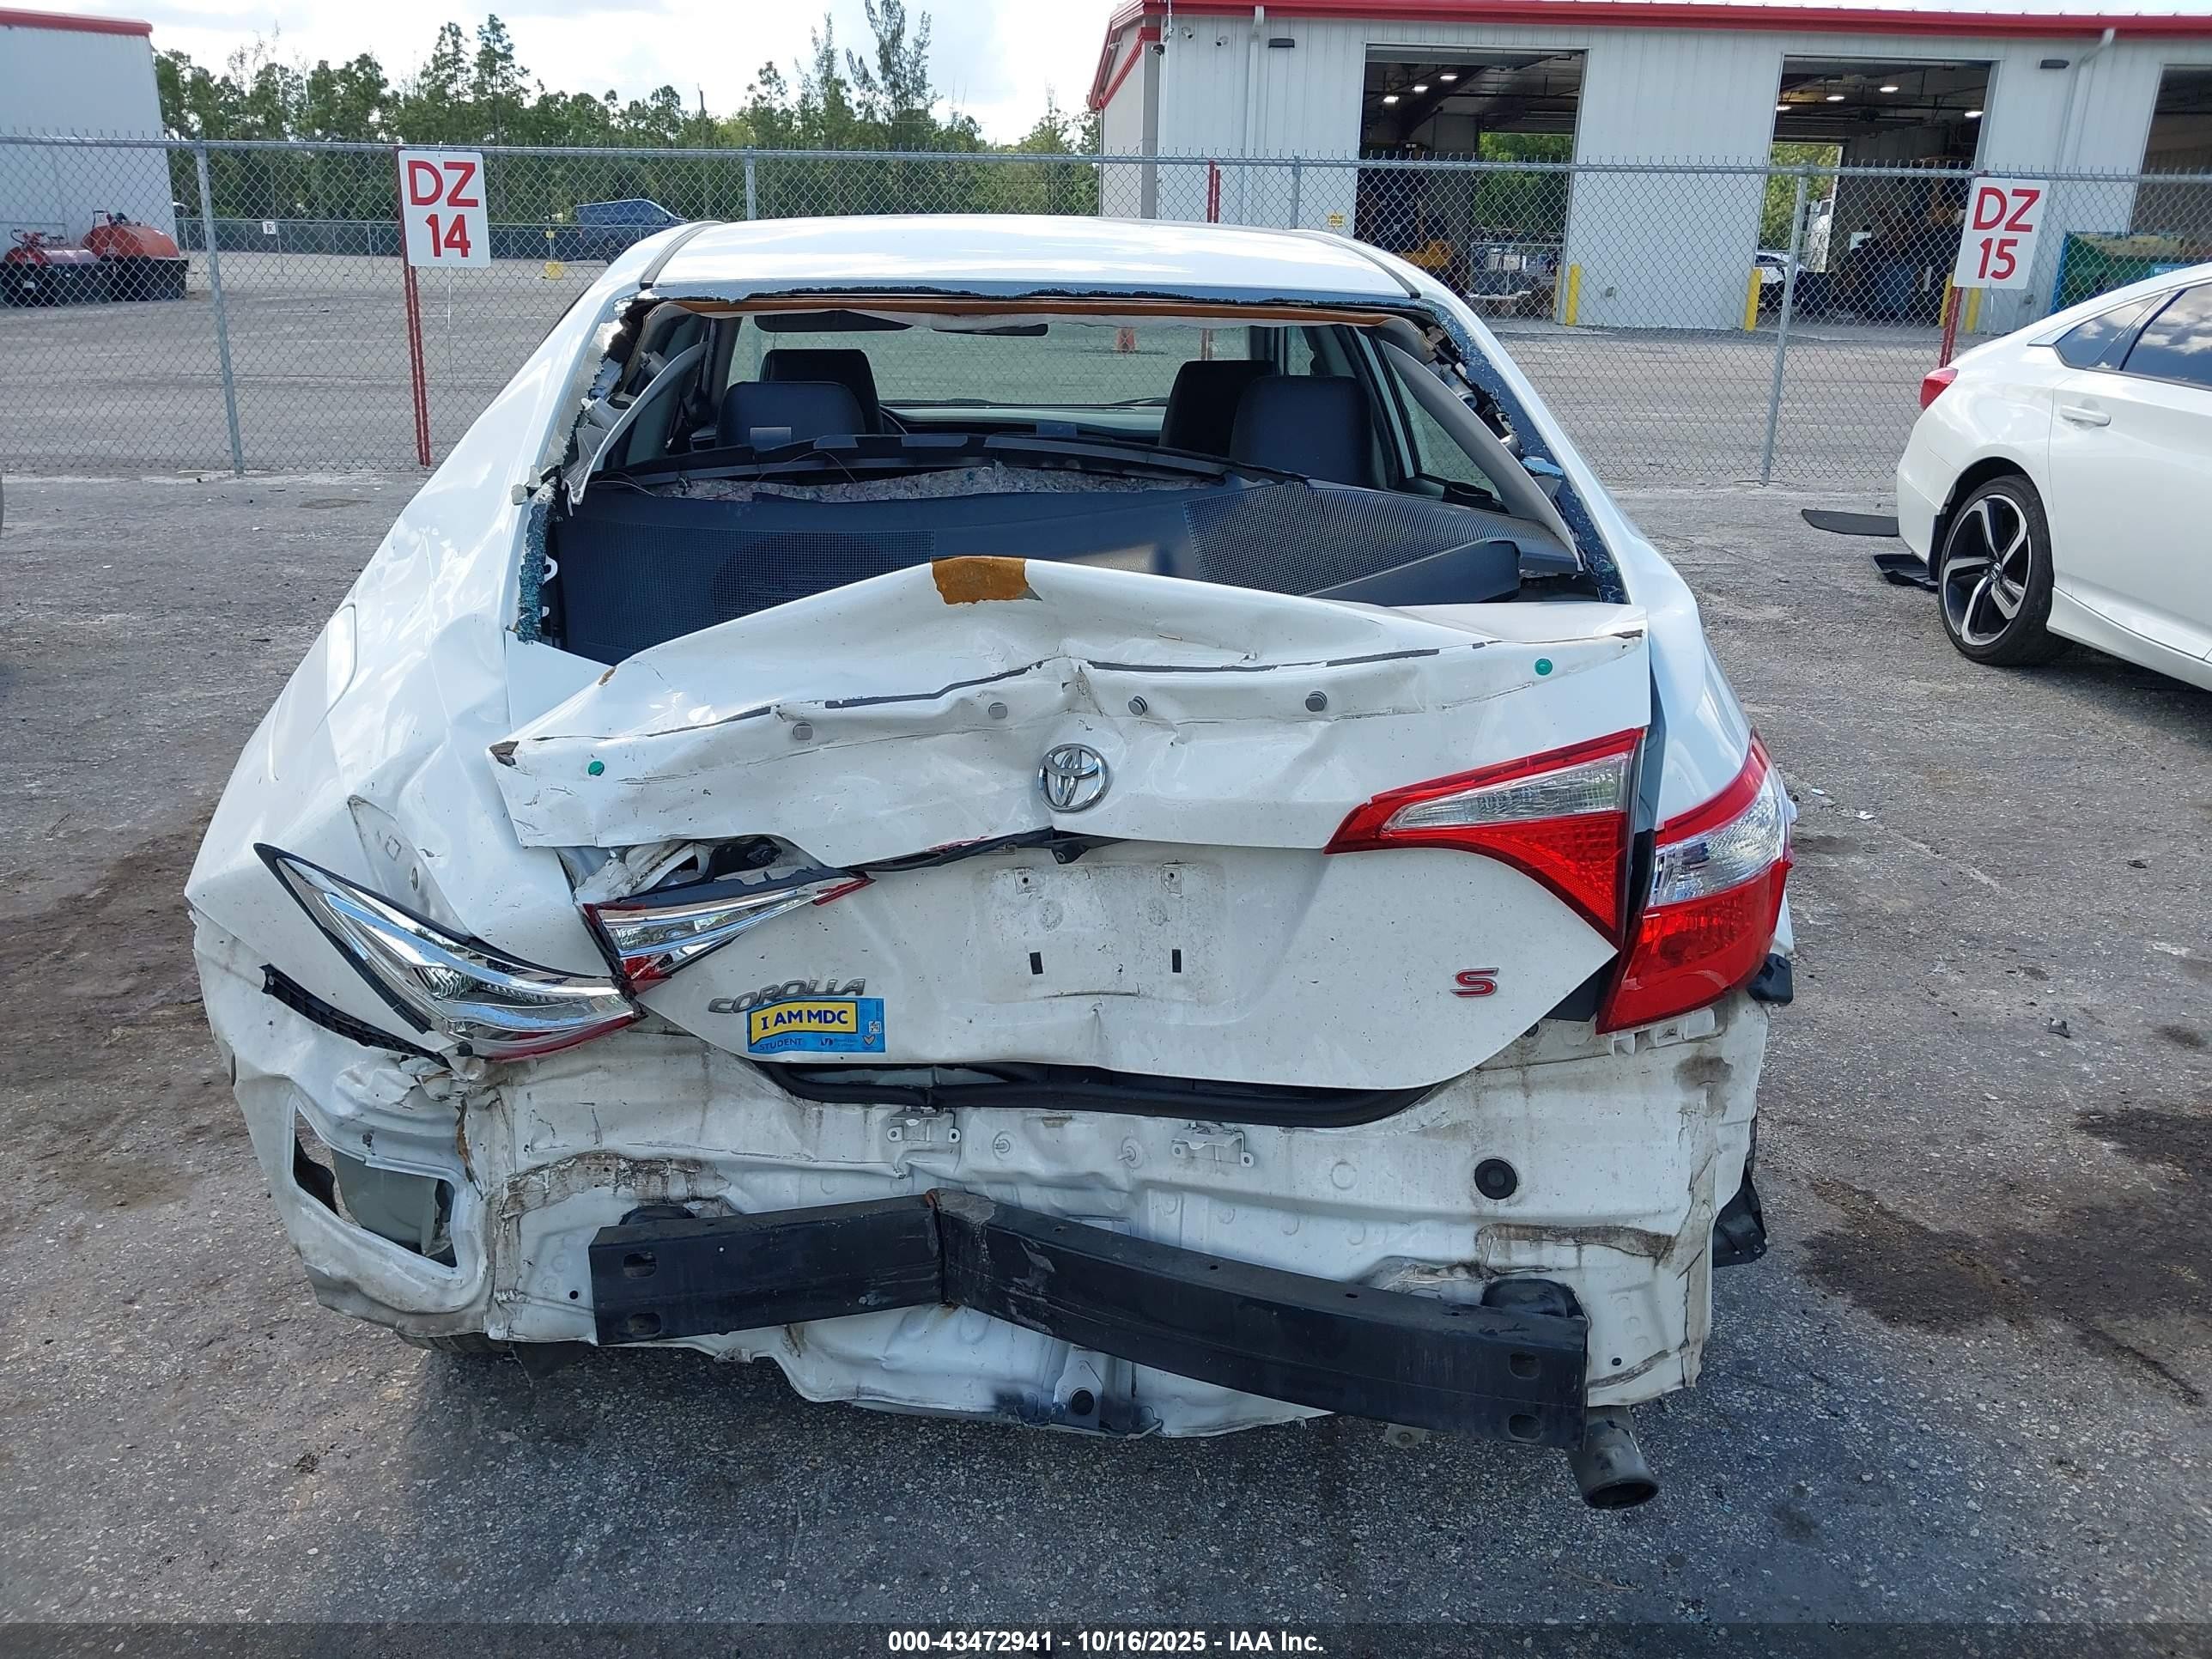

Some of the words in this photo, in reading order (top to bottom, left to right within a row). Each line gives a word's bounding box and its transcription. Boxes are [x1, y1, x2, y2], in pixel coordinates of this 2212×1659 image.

[407, 160, 479, 208] DZ
[1972, 186, 2041, 233] DZ
[425, 213, 471, 258] 14
[1978, 237, 2019, 280] 15
[708, 978, 866, 1014] COROLLA
[1449, 967, 1500, 998] S
[761, 1016, 769, 1031] I
[774, 1009, 803, 1028] AM
[807, 1009, 848, 1025] MDC
[759, 1037, 804, 1051] STUDENT
